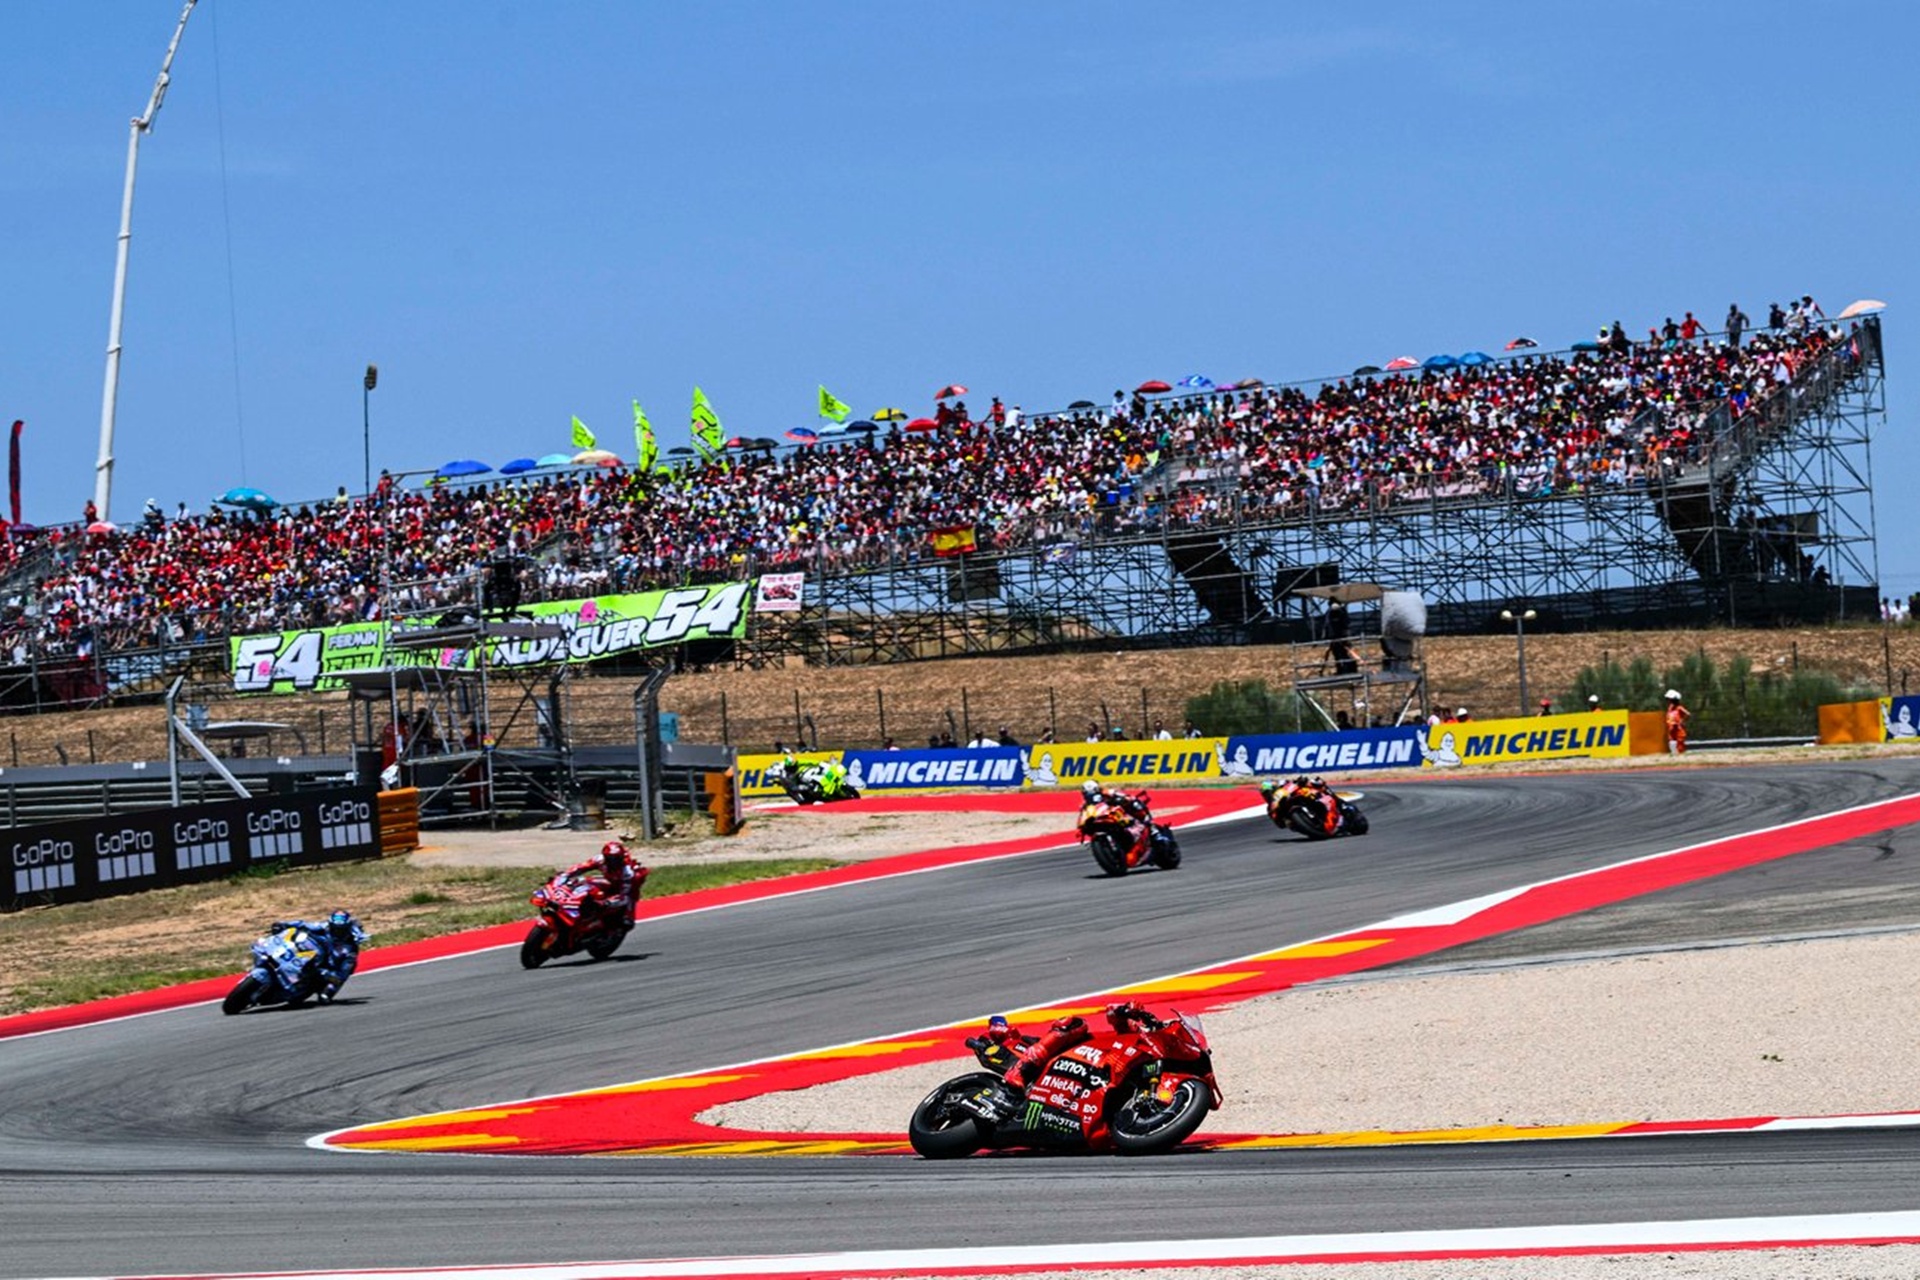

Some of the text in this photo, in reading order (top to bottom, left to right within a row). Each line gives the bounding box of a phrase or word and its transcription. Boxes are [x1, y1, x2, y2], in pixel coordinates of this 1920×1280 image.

[645, 583, 748, 642] 54
[233, 631, 322, 690] 54
[1464, 724, 1627, 757] MICHELIN
[1060, 752, 1214, 777] MICHELIN
[1254, 737, 1414, 772] MICHELIN
[867, 759, 1018, 784] MICHELIN
[247, 809, 301, 834] GoPro
[318, 801, 371, 825] GoPro
[95, 829, 154, 855] GoPro
[174, 818, 229, 844] GoPro
[13, 840, 74, 867] GoPro
[1050, 1093, 1079, 1111] elica
